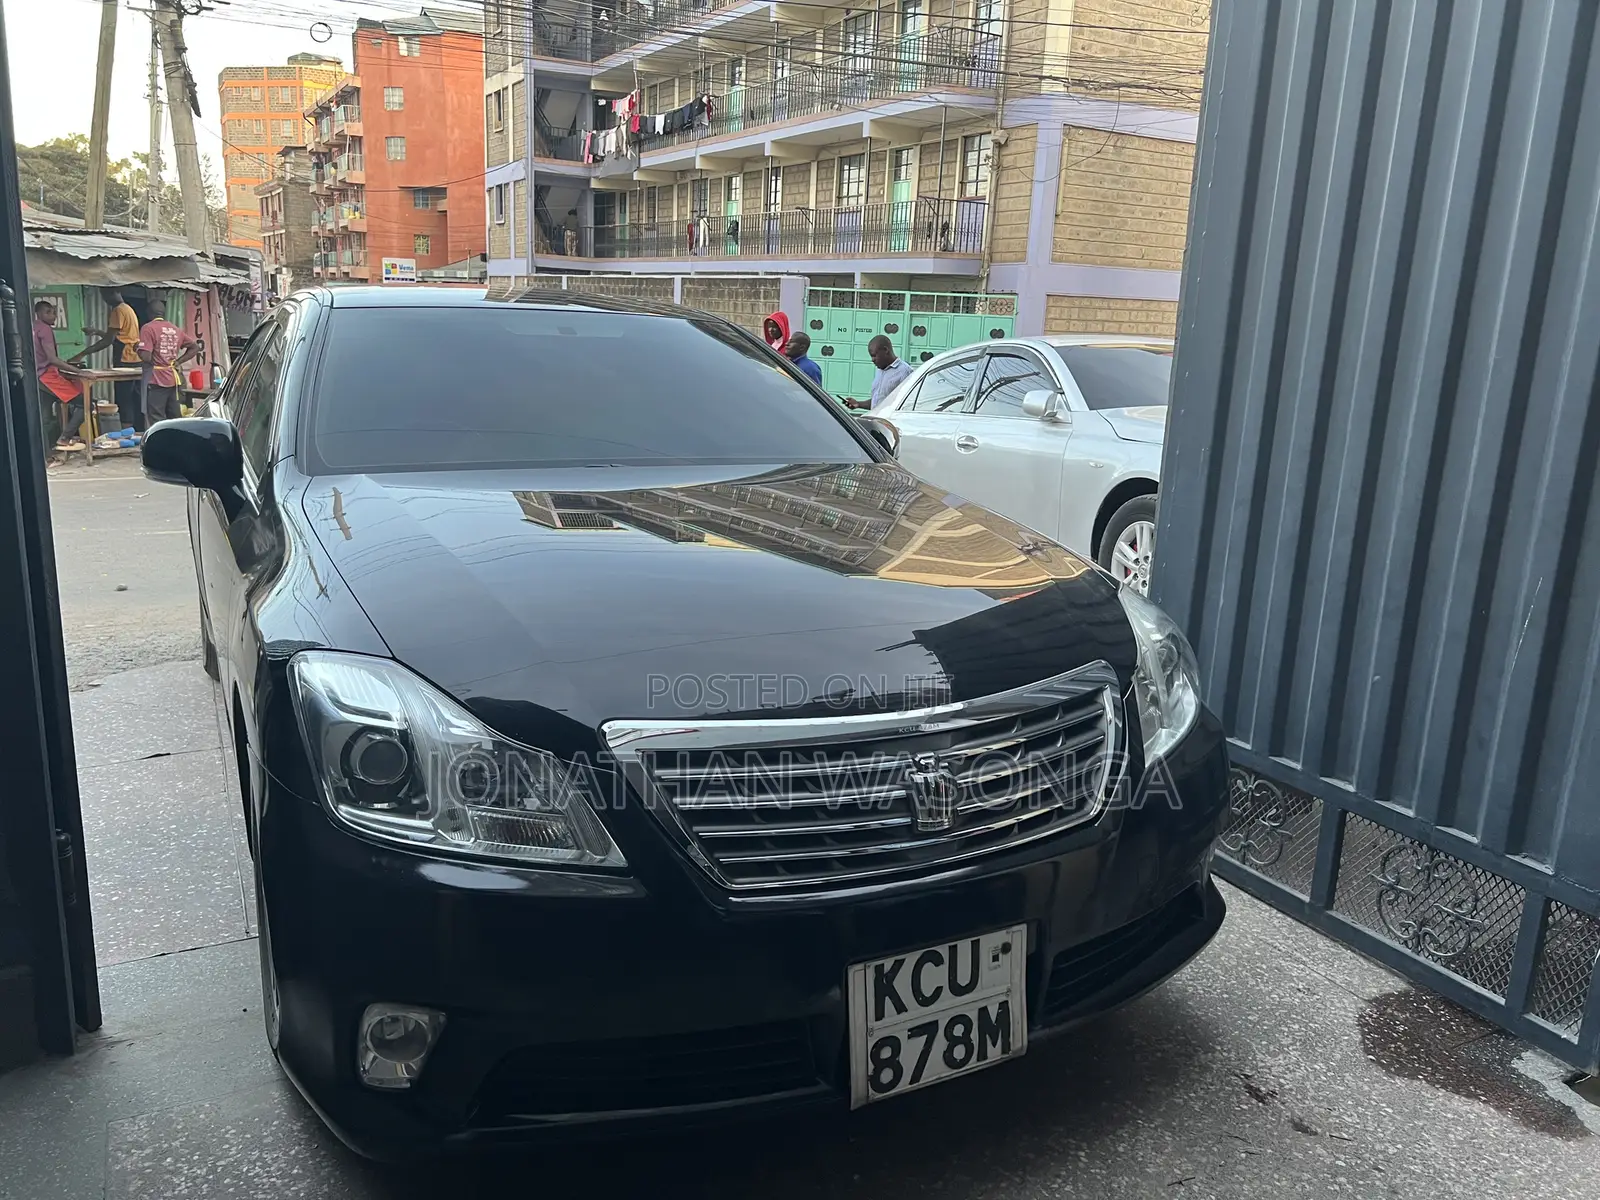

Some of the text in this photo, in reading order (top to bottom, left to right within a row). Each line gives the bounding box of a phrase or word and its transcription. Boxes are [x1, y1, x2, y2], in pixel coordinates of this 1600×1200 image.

[193, 292, 206, 366] SALON
[898, 726, 917, 734] KCU
[873, 938, 981, 1022] KCU
[867, 999, 1012, 1094] 878M
